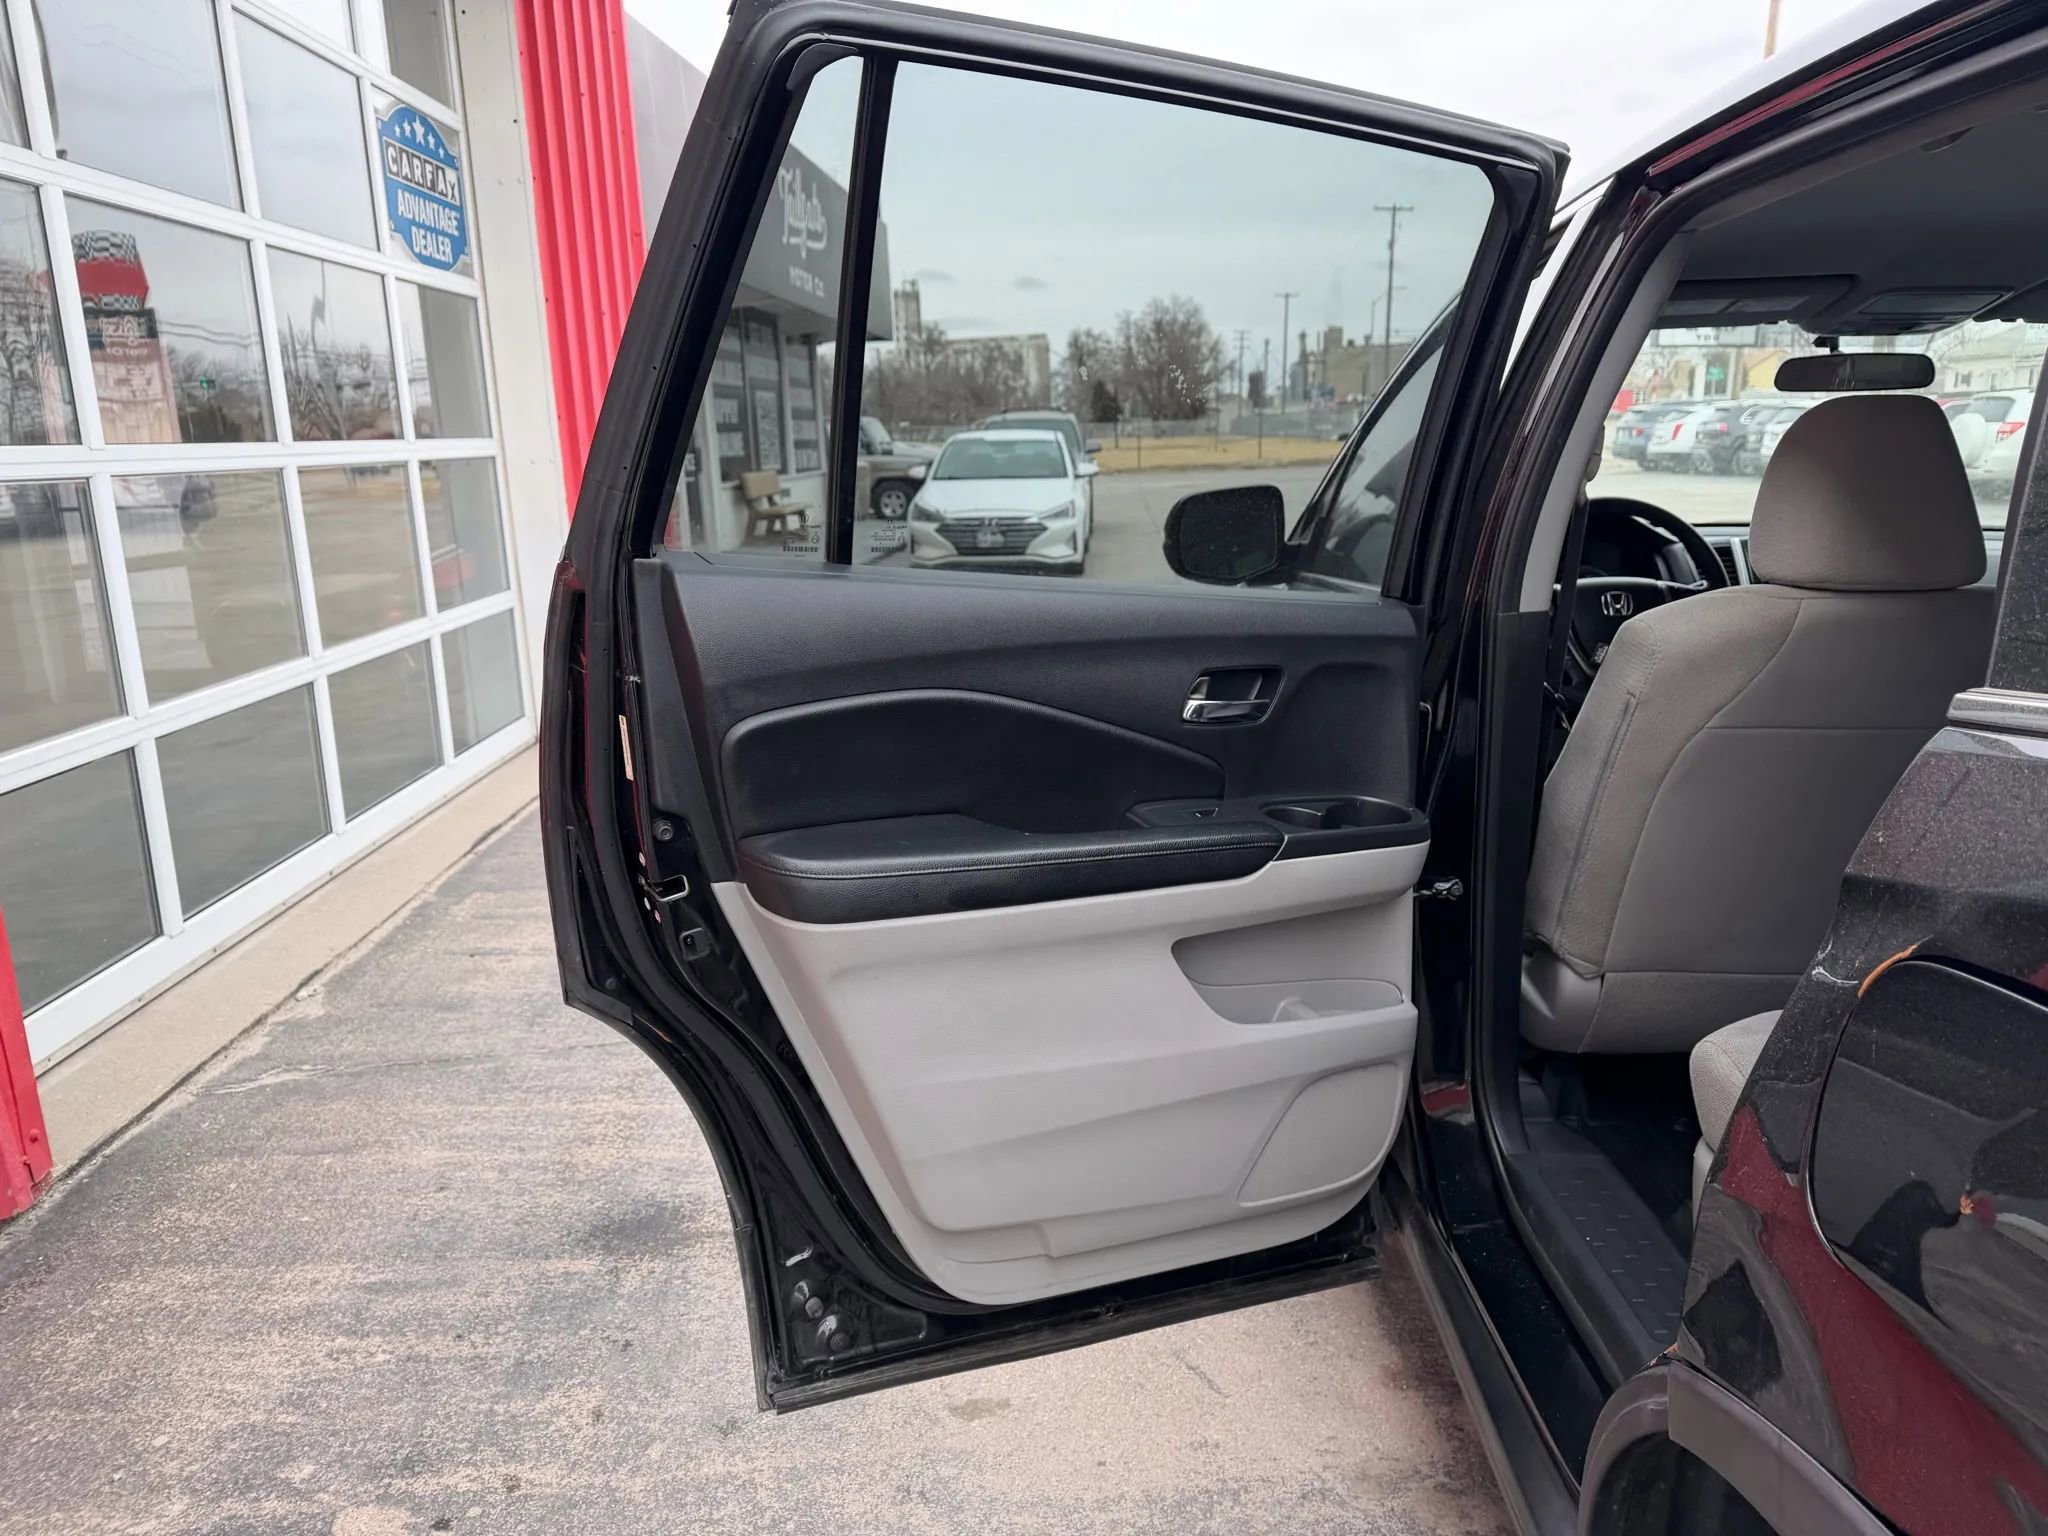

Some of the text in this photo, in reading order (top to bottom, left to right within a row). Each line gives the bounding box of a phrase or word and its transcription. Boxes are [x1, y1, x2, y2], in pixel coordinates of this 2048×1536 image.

[387, 146, 458, 202] CARFAX
[397, 189, 460, 237] ADVANTAGE
[411, 225, 453, 264] DEALER
